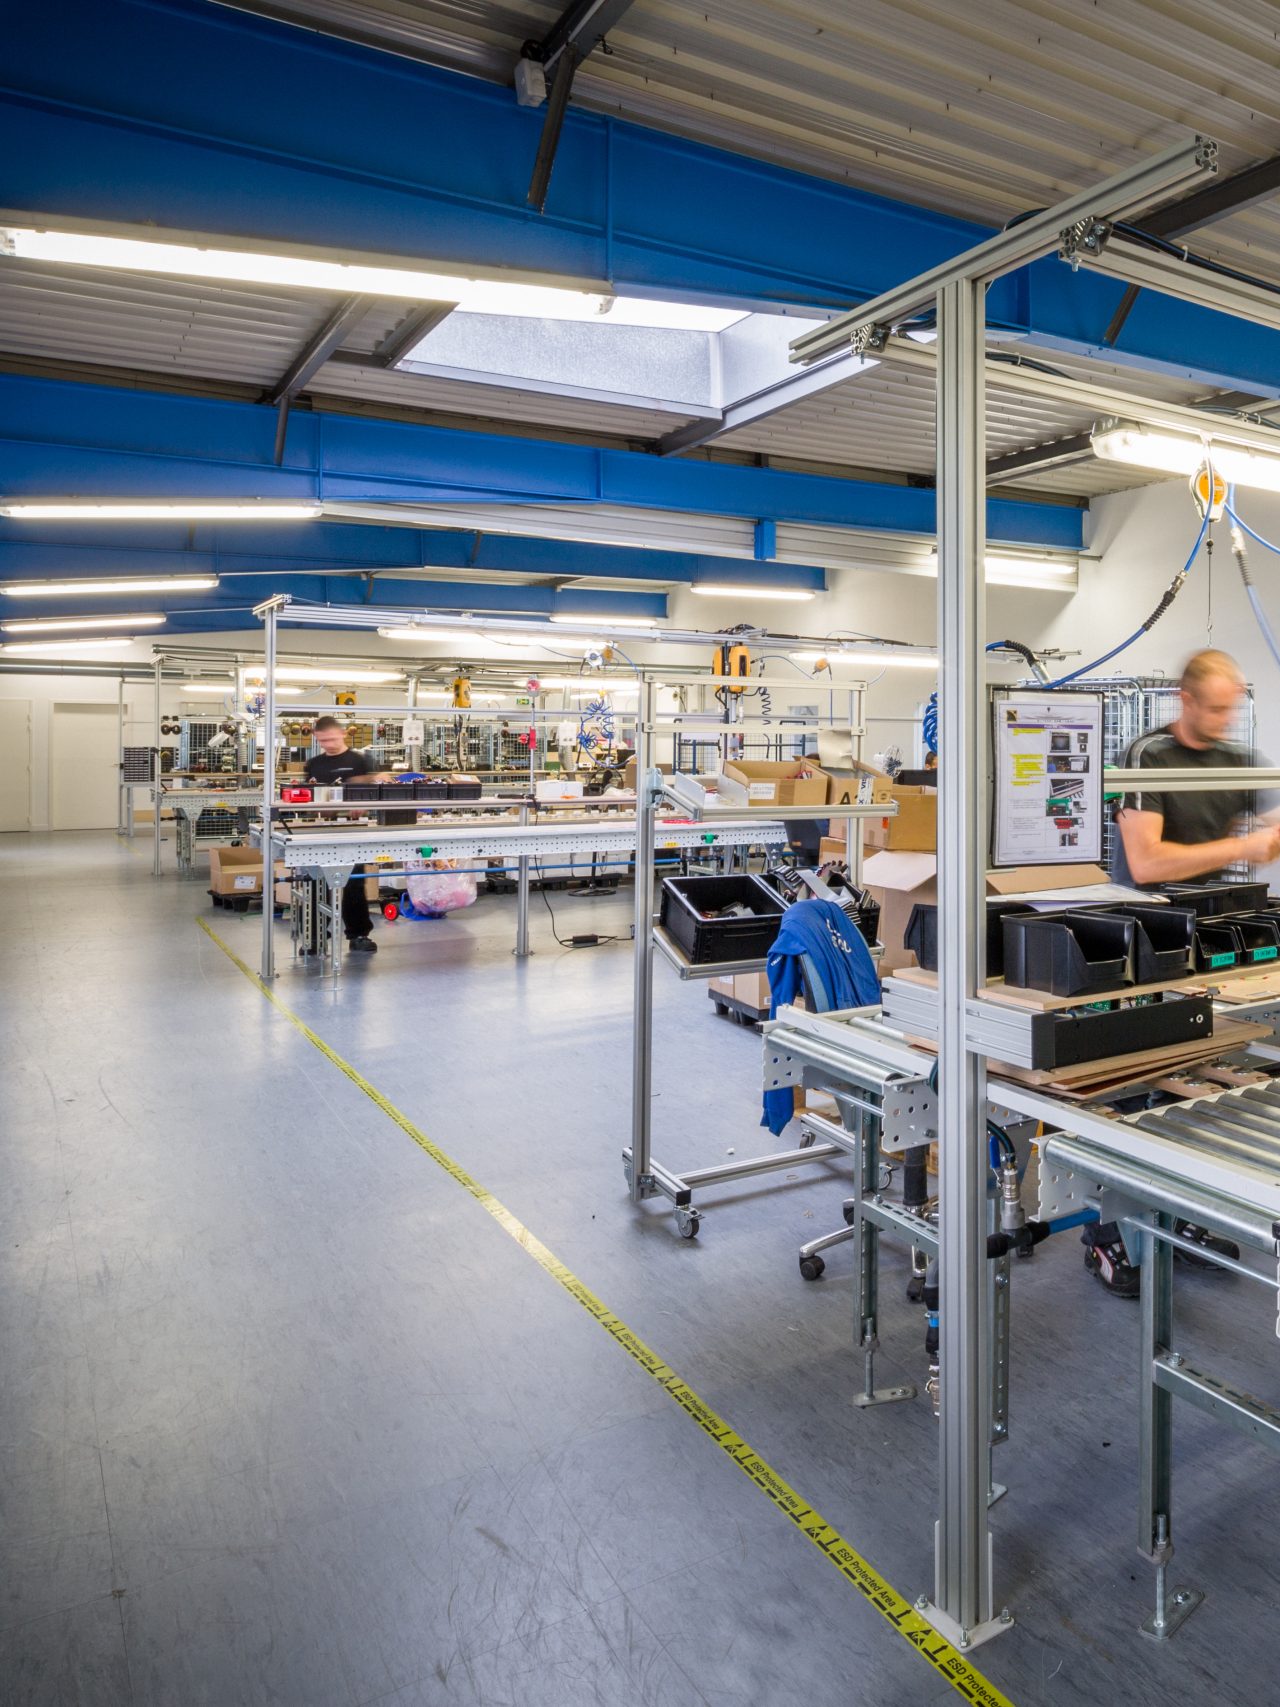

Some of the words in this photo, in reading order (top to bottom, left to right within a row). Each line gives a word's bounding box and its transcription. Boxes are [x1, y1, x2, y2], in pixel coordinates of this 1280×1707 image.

[680, 1391, 693, 1401] ESD
[707, 1419, 720, 1430] Area
[750, 1461, 765, 1473] ESD
[760, 1472, 788, 1497] Protected
[784, 1495, 799, 1508] Area
[836, 1548, 854, 1562] ESD
[850, 1561, 884, 1592] Protected
[878, 1591, 897, 1608] Area
[946, 1657, 967, 1675] ESD
[963, 1673, 1002, 1707] Protecte
